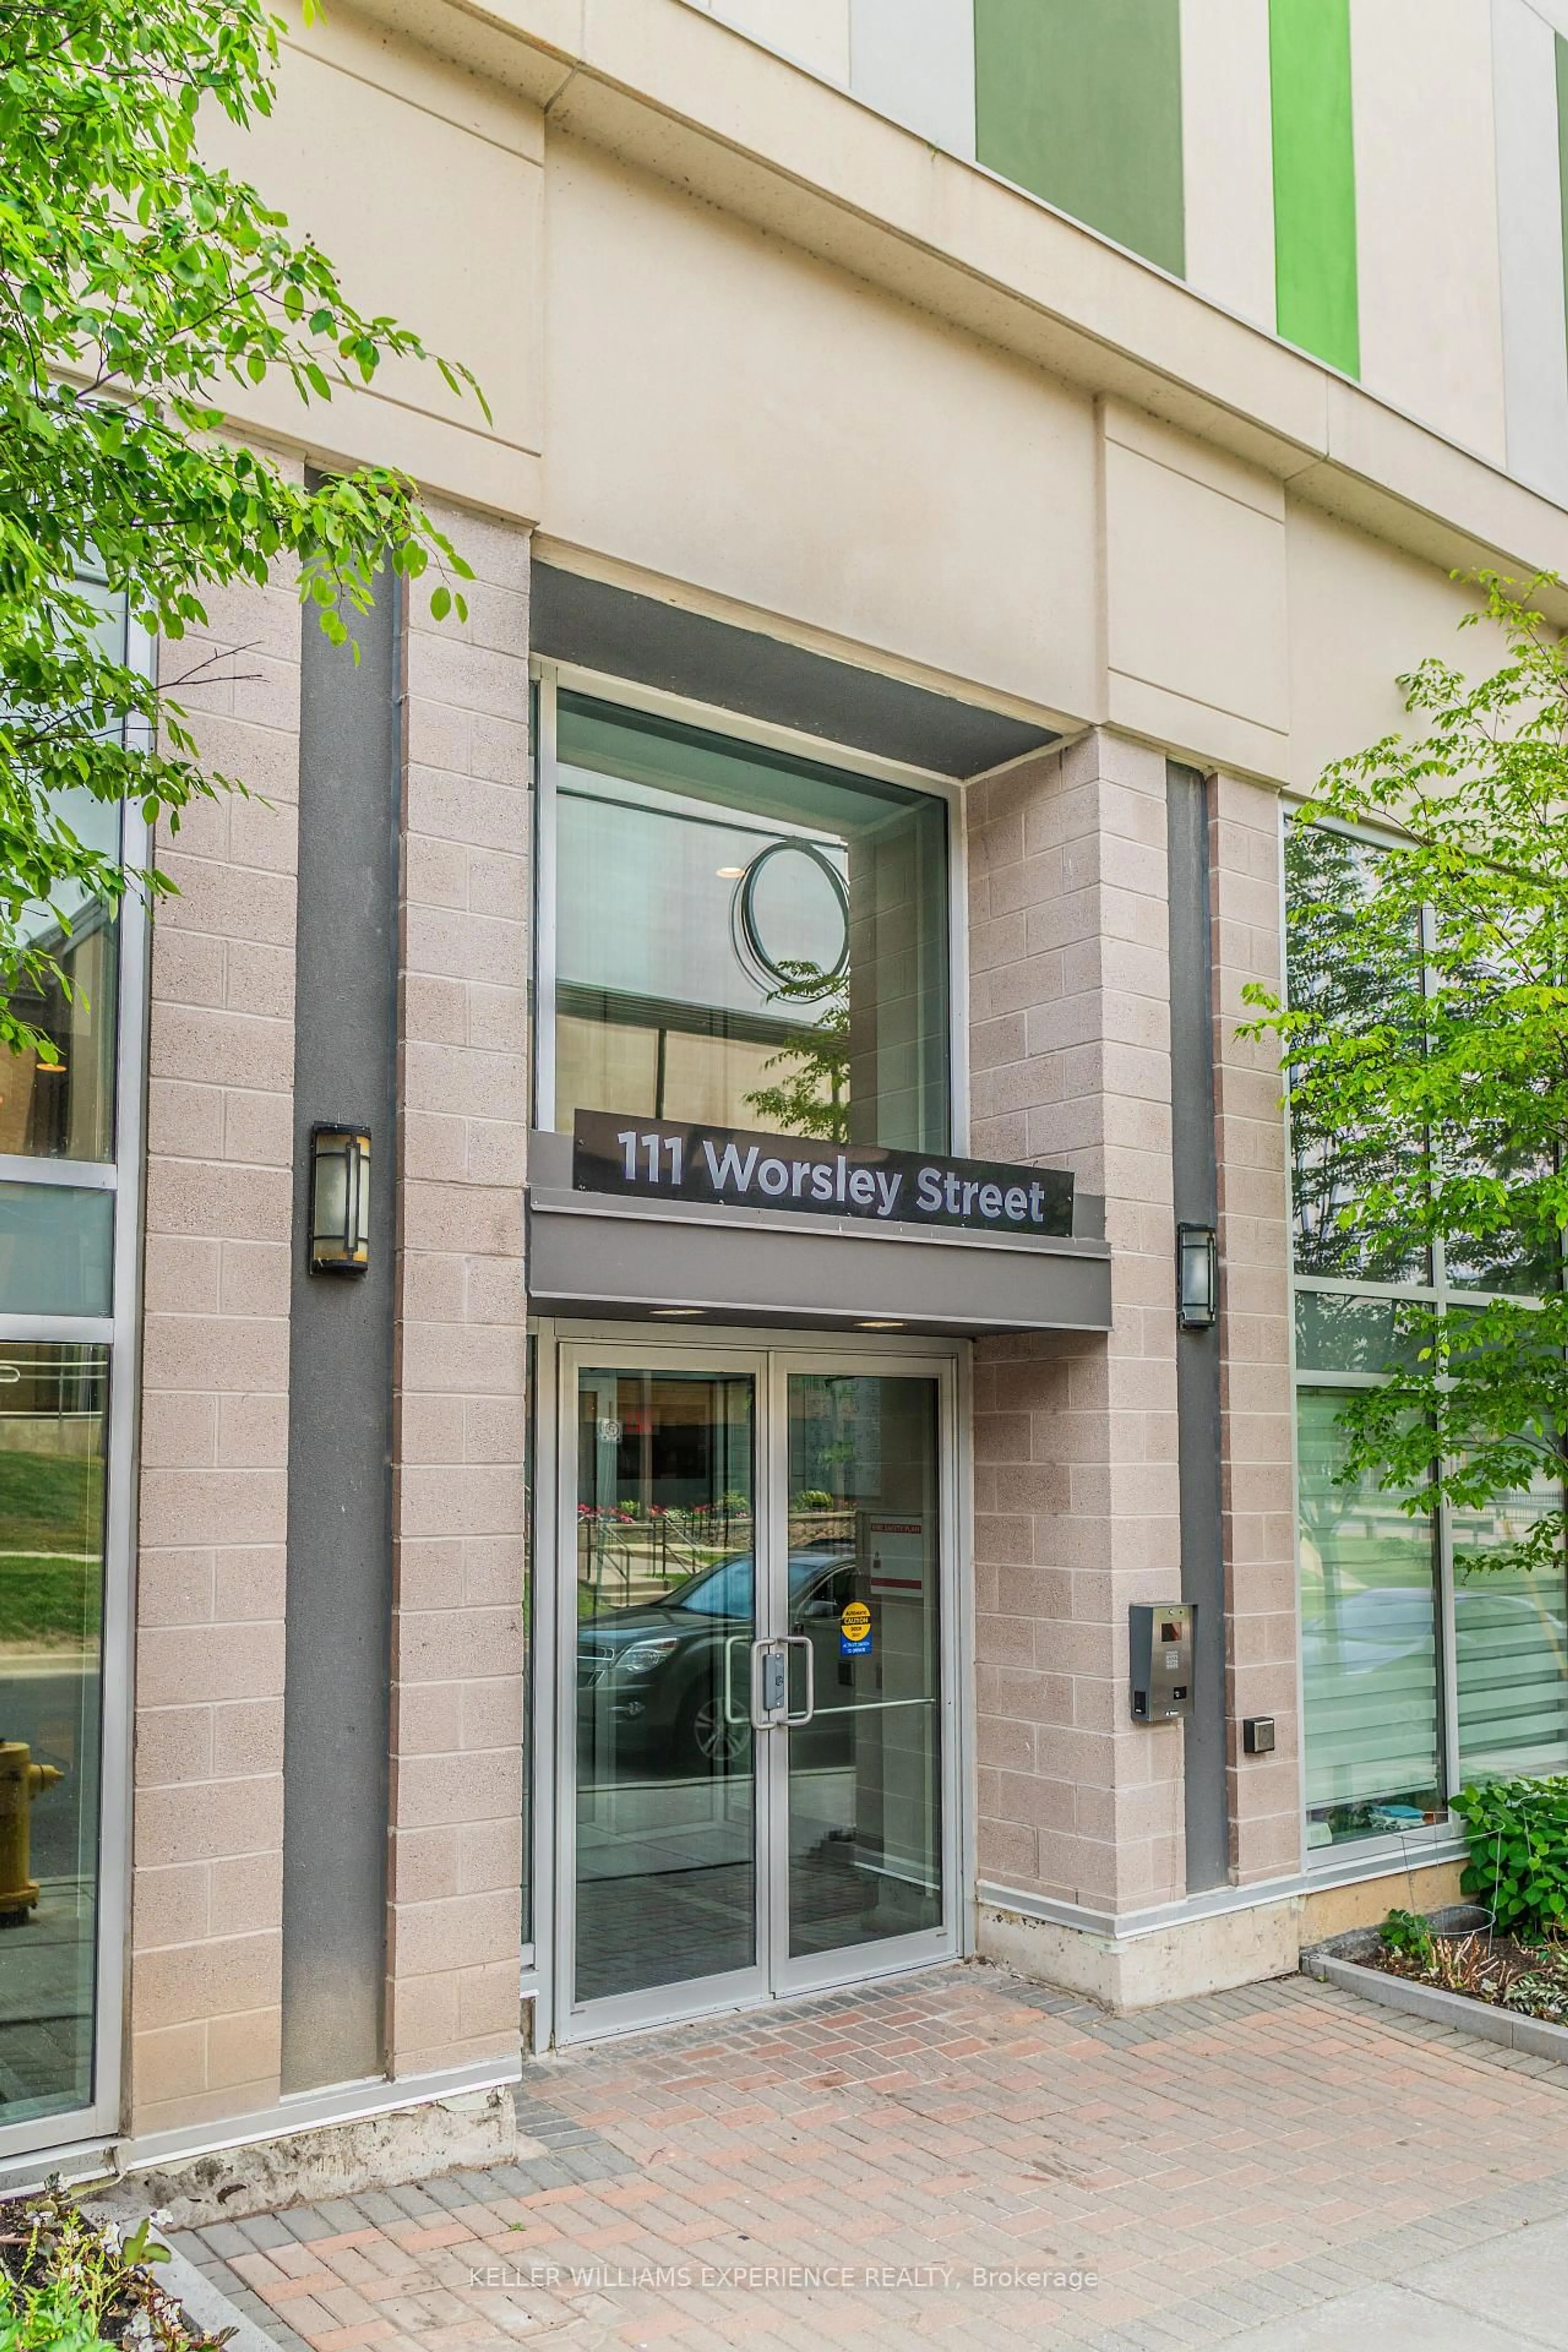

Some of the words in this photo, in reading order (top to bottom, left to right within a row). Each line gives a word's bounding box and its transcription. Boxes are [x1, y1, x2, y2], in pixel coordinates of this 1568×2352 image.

[618, 1131, 682, 1184] 111
[703, 1140, 902, 1216] Worsley
[916, 1167, 1045, 1222] Street
